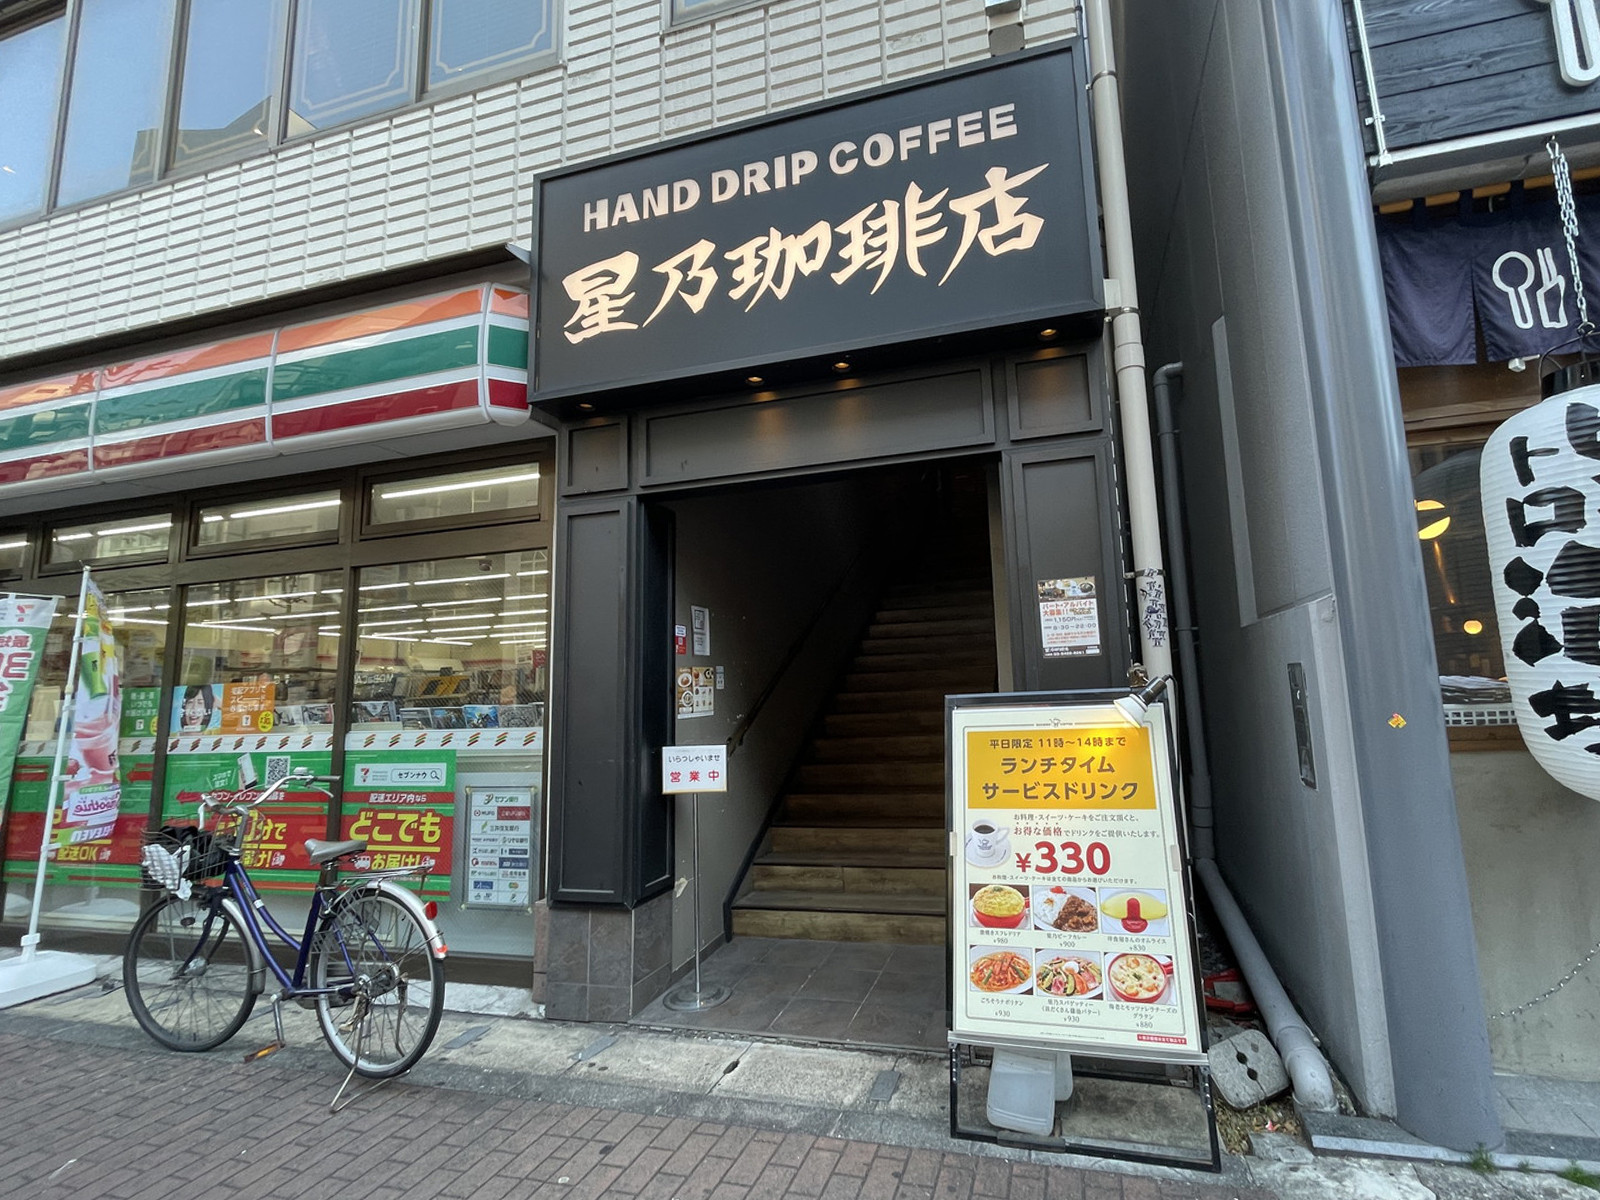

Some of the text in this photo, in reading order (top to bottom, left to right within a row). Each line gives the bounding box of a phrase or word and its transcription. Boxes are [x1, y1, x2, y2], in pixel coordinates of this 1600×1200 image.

[583, 102, 1018, 233] HAND DRIP COFFEE
[562, 163, 1050, 345] 星乃珈琲店
[989, 738, 1033, 749] 平日限定
[670, 770, 720, 783] 営業中
[1001, 757, 1115, 775] ランチタイム
[982, 782, 1138, 800] サービスドリンク
[349, 812, 441, 844] どこでも
[1015, 841, 1111, 876] ¥330
